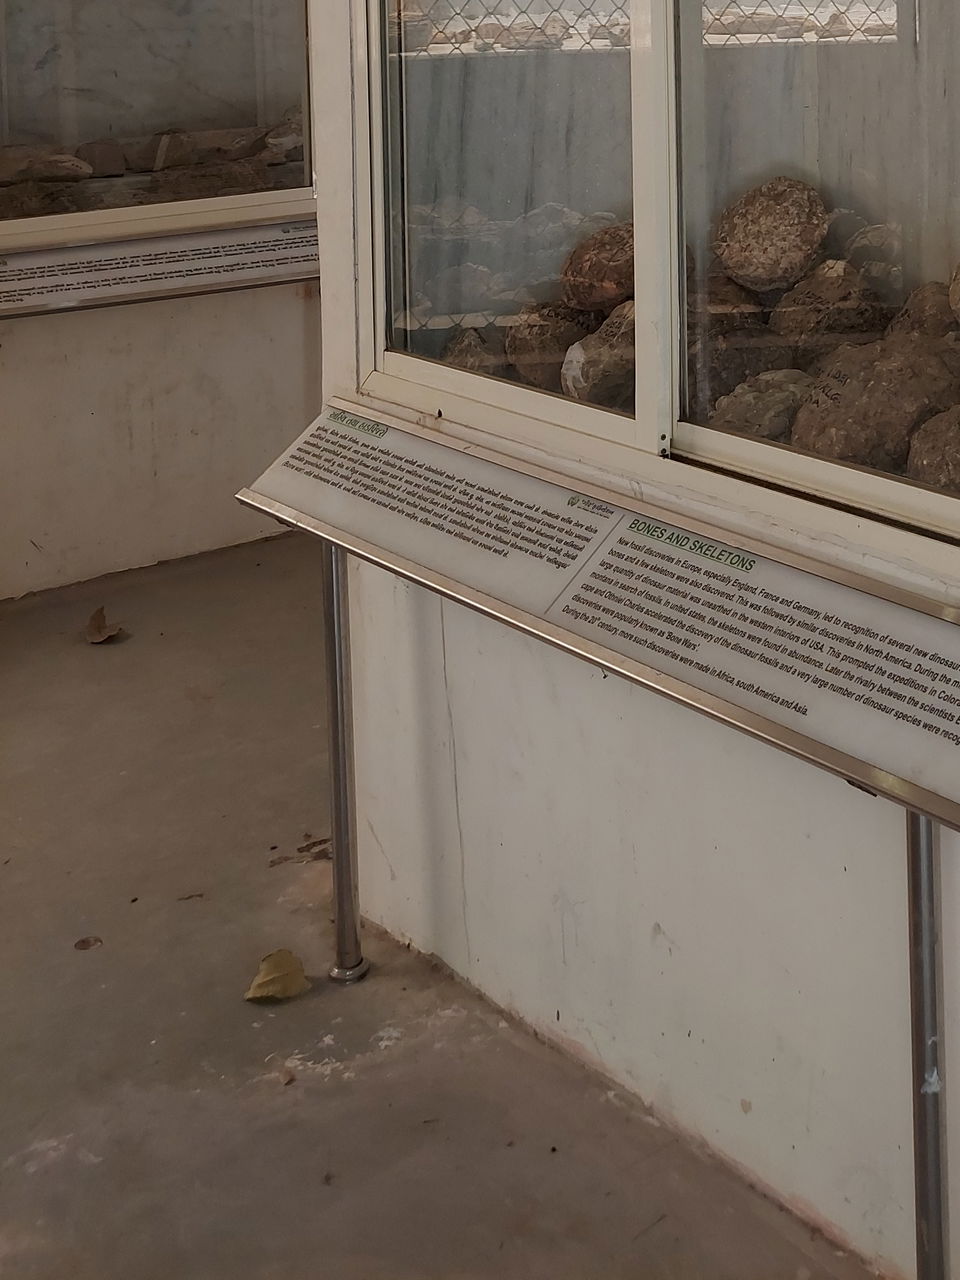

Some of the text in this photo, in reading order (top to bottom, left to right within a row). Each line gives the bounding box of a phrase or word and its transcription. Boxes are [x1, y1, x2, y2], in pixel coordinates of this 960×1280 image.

[617, 537, 630, 546] New
[628, 541, 646, 552] fossil
[643, 547, 675, 563] discoveries
[674, 557, 681, 566] in
[680, 560, 702, 575] Europe,
[703, 570, 732, 586] especially
[731, 578, 758, 595] England,
[758, 588, 780, 602] France
[779, 598, 794, 607] and
[792, 601, 822, 619] Germany,
[822, 612, 835, 622] led
[832, 617, 841, 625] to
[840, 621, 879, 640] recognition
[887, 638, 914, 652] several
[912, 648, 929, 658] new
[629, 518, 755, 570] BONES AND SKELETONS
[562, 605, 807, 715] During the century, more such discoveries were made in Africa, south America and Asia.
[571, 594, 602, 610] discoveries
[601, 607, 615, 616] were
[612, 612, 641, 628] popularly
[638, 620, 658, 634] known
[665, 631, 682, 644] 'Bone
[681, 638, 700, 651] Wars'.
[581, 583, 595, 592] cape
[593, 588, 607, 596] and
[604, 591, 626, 604] Othniel
[623, 598, 645, 613] Charles
[643, 608, 678, 625] accelerated
[675, 620, 686, 629] the
[685, 624, 715, 642] discovery
[713, 636, 723, 644] of
[720, 638, 731, 648] the
[730, 643, 759, 658] dinosaur
[757, 652, 779, 667] fossils
[778, 663, 793, 672] and
[797, 670, 812, 682] very
[810, 674, 829, 688] large
[827, 683, 856, 698] number
[854, 694, 865, 702] of
[862, 696, 895, 714] dinosaur
[893, 710, 922, 726] species
[922, 722, 940, 734] were
[590, 572, 613, 584] montana
[612, 578, 619, 587] in
[618, 583, 638, 594] search
[643, 591, 662, 604] fossils.
[663, 599, 670, 607] In
[669, 603, 690, 614] united
[687, 610, 706, 623] states,
[707, 617, 718, 626] the
[717, 621, 747, 637] skeletons
[746, 633, 762, 644] were
[761, 638, 783, 651] found
[780, 645, 788, 654] in
[787, 649, 823, 669] abundance.
[824, 663, 844, 676] Later
[842, 670, 855, 681] the
[854, 675, 877, 691] rivalry
[876, 683, 907, 702] between
[906, 696, 919, 707] the
[919, 702, 955, 721] scientists
[599, 559, 613, 570] large
[613, 566, 635, 579] quantity
[641, 576, 667, 590] dinosaur
[665, 586, 691, 599] material
[689, 595, 701, 603] was
[701, 600, 733, 615] unearthed
[730, 610, 738, 618] in
[737, 613, 749, 622] the
[749, 618, 773, 632] western
[773, 626, 800, 642] interiors
[800, 638, 811, 646] of
[808, 639, 824, 652] USA.
[826, 646, 841, 658] This
[839, 654, 876, 671] prompted
[874, 666, 887, 676] the
[887, 672, 928, 693] expeditions
[928, 686, 937, 696] in
[608, 548, 625, 559] bones
[624, 555, 637, 563] and
[638, 559, 650, 568] few
[649, 564, 676, 578] skeletons
[675, 575, 690, 584] were
[689, 579, 702, 588] also
[701, 583, 735, 601] discovered.
[735, 595, 749, 606] This
[748, 602, 762, 611] was
[761, 605, 790, 621] followed
[787, 616, 797, 626] by
[796, 619, 820, 633] similar
[818, 627, 856, 647] discoveries
[855, 641, 863, 650] in
[863, 644, 883, 658] North
[882, 652, 912, 670] America.
[913, 663, 939, 681] During
[938, 673, 951, 684] the
